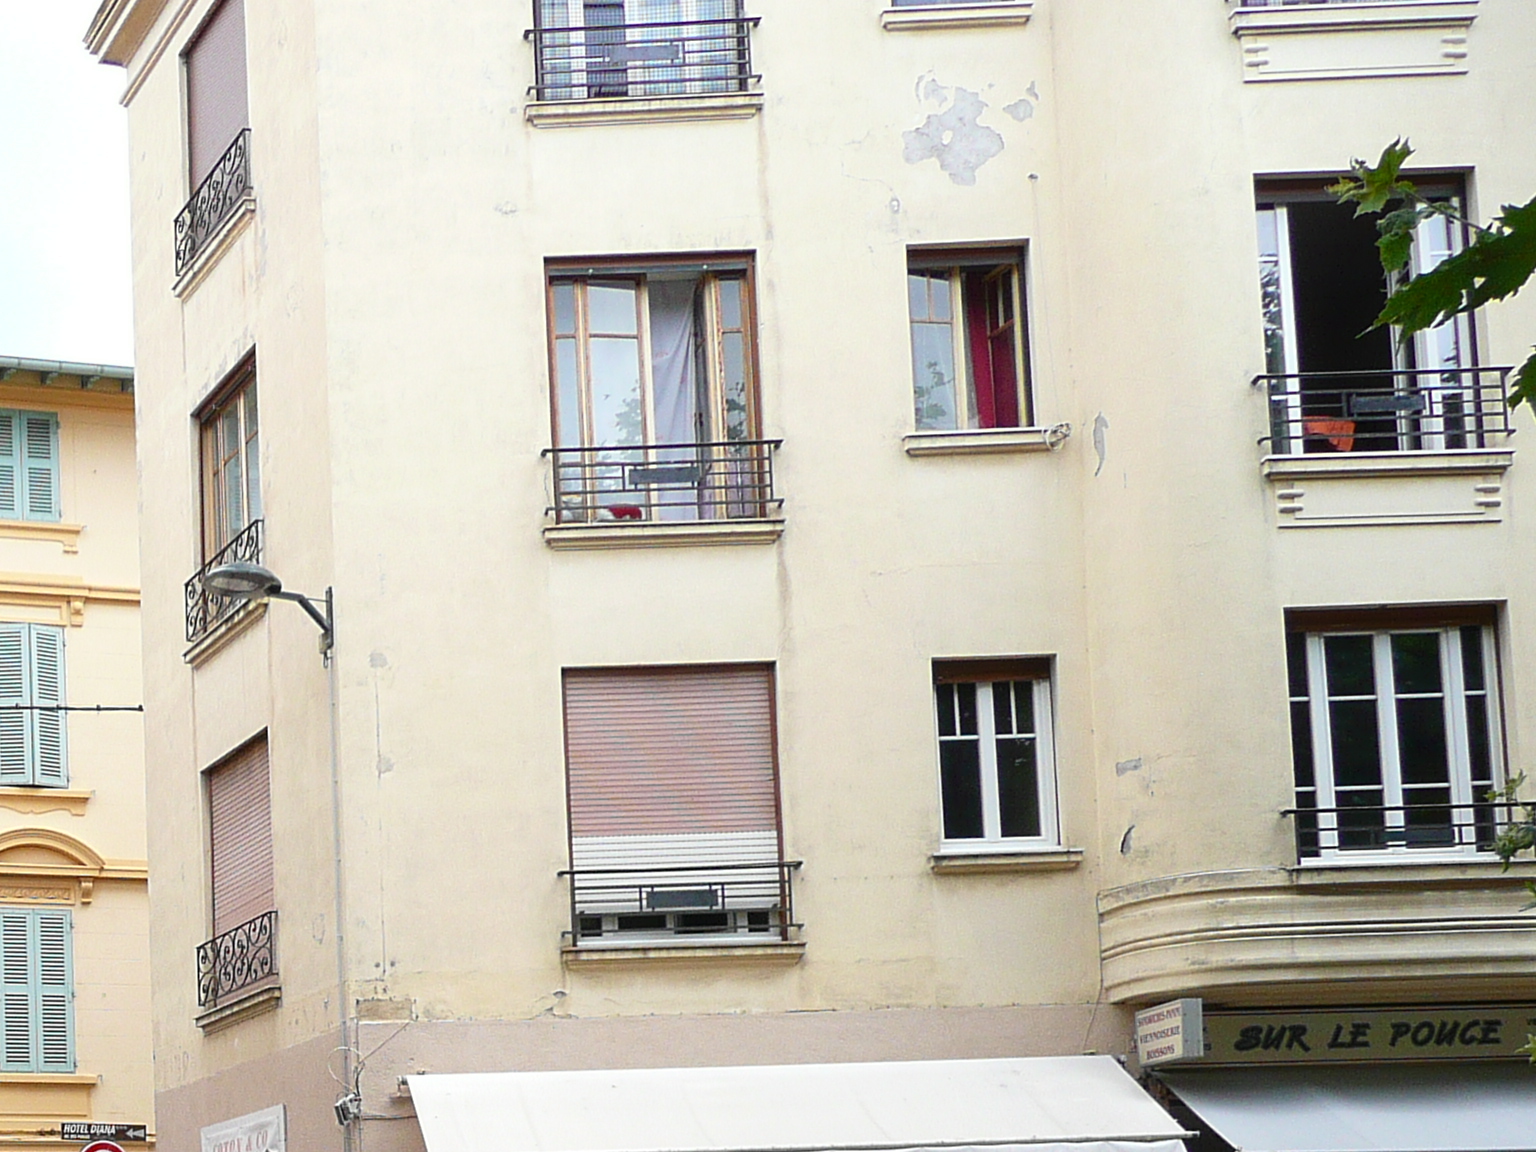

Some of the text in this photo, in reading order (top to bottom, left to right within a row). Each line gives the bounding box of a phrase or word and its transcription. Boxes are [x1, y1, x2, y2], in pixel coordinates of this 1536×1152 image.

[1234, 1024, 1311, 1052] SUR
[1327, 1022, 1372, 1049] LE
[1389, 1018, 1504, 1047] POUCE
[64, 1124, 116, 1136] HOTEL DIANA
[256, 1129, 268, 1150] CO
